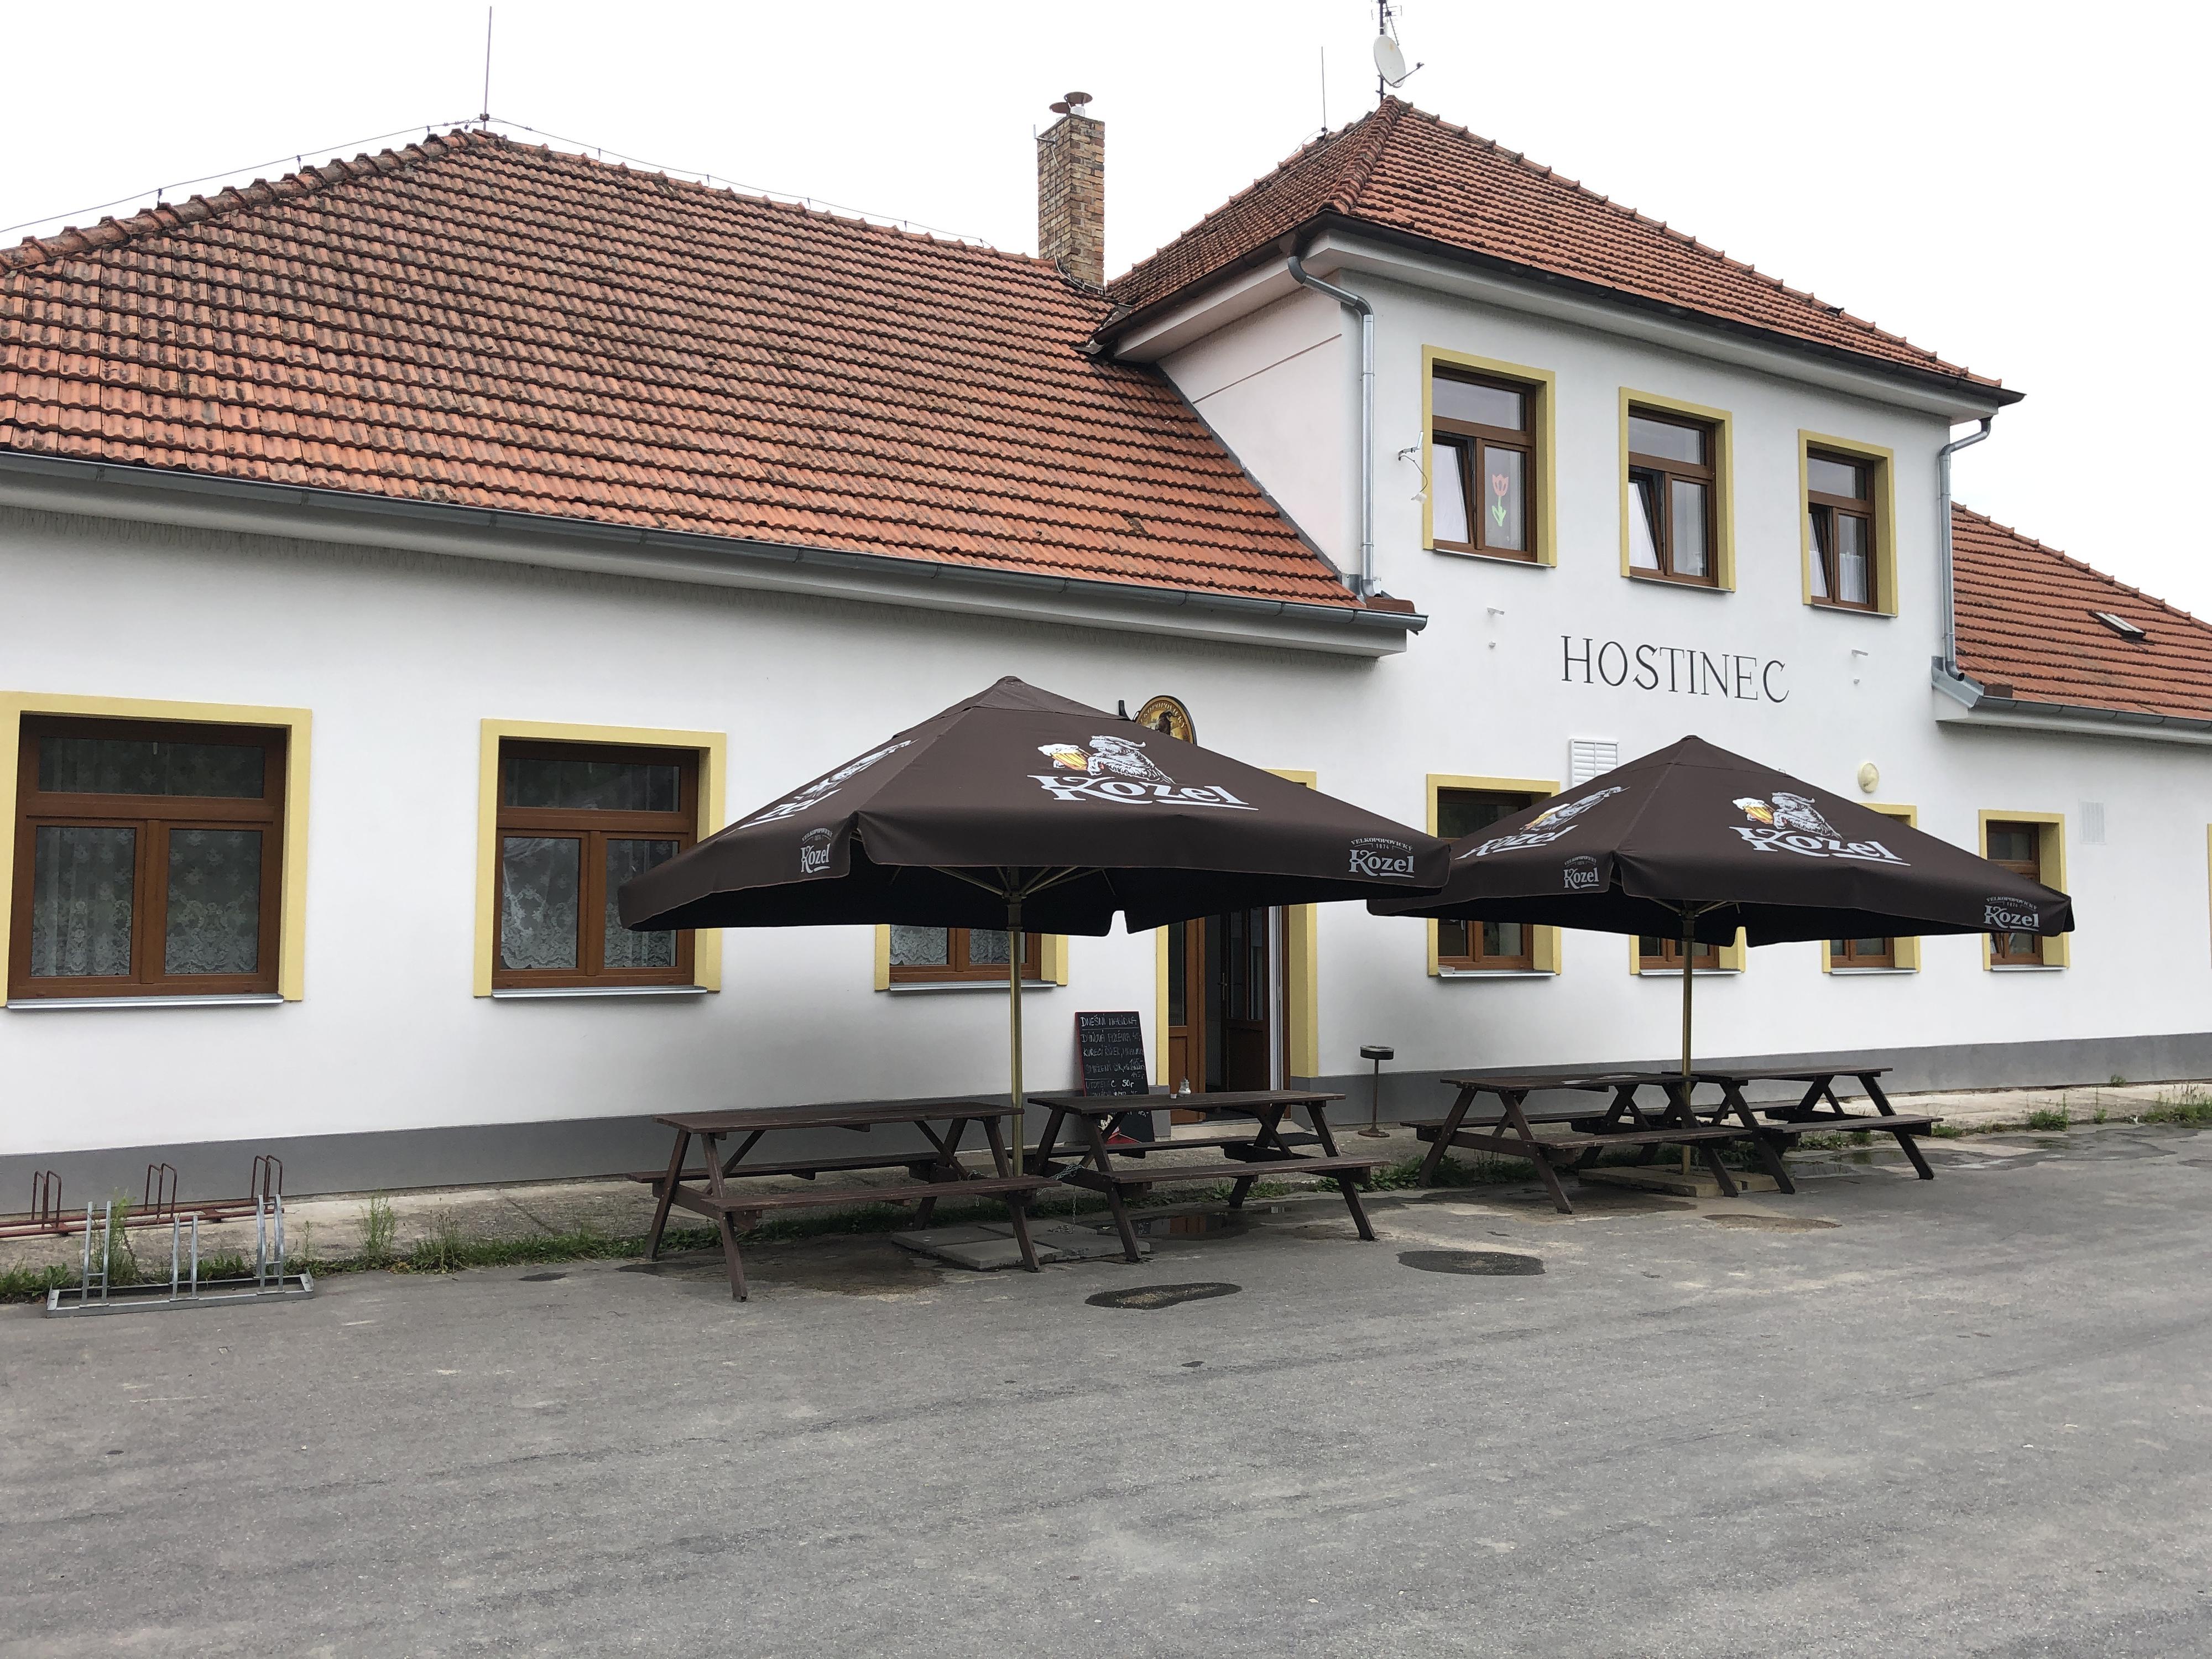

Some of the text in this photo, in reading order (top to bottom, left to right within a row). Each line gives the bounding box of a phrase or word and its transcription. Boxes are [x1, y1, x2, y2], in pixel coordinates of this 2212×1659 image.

[1561, 635, 1790, 703] HOSTINEC
[753, 788, 843, 820] zel
[1027, 775, 1250, 805] Kozel
[1350, 837, 1413, 851] VELKOPOPOVICKÝ
[1729, 826, 1903, 860] Kozel
[800, 843, 831, 873] Kozel
[1348, 849, 1415, 877] Kozel
[1563, 867, 1599, 889] Kozel
[1984, 905, 2040, 929] Kozel
[1080, 1013, 1106, 1027] DNEŠNÍ
